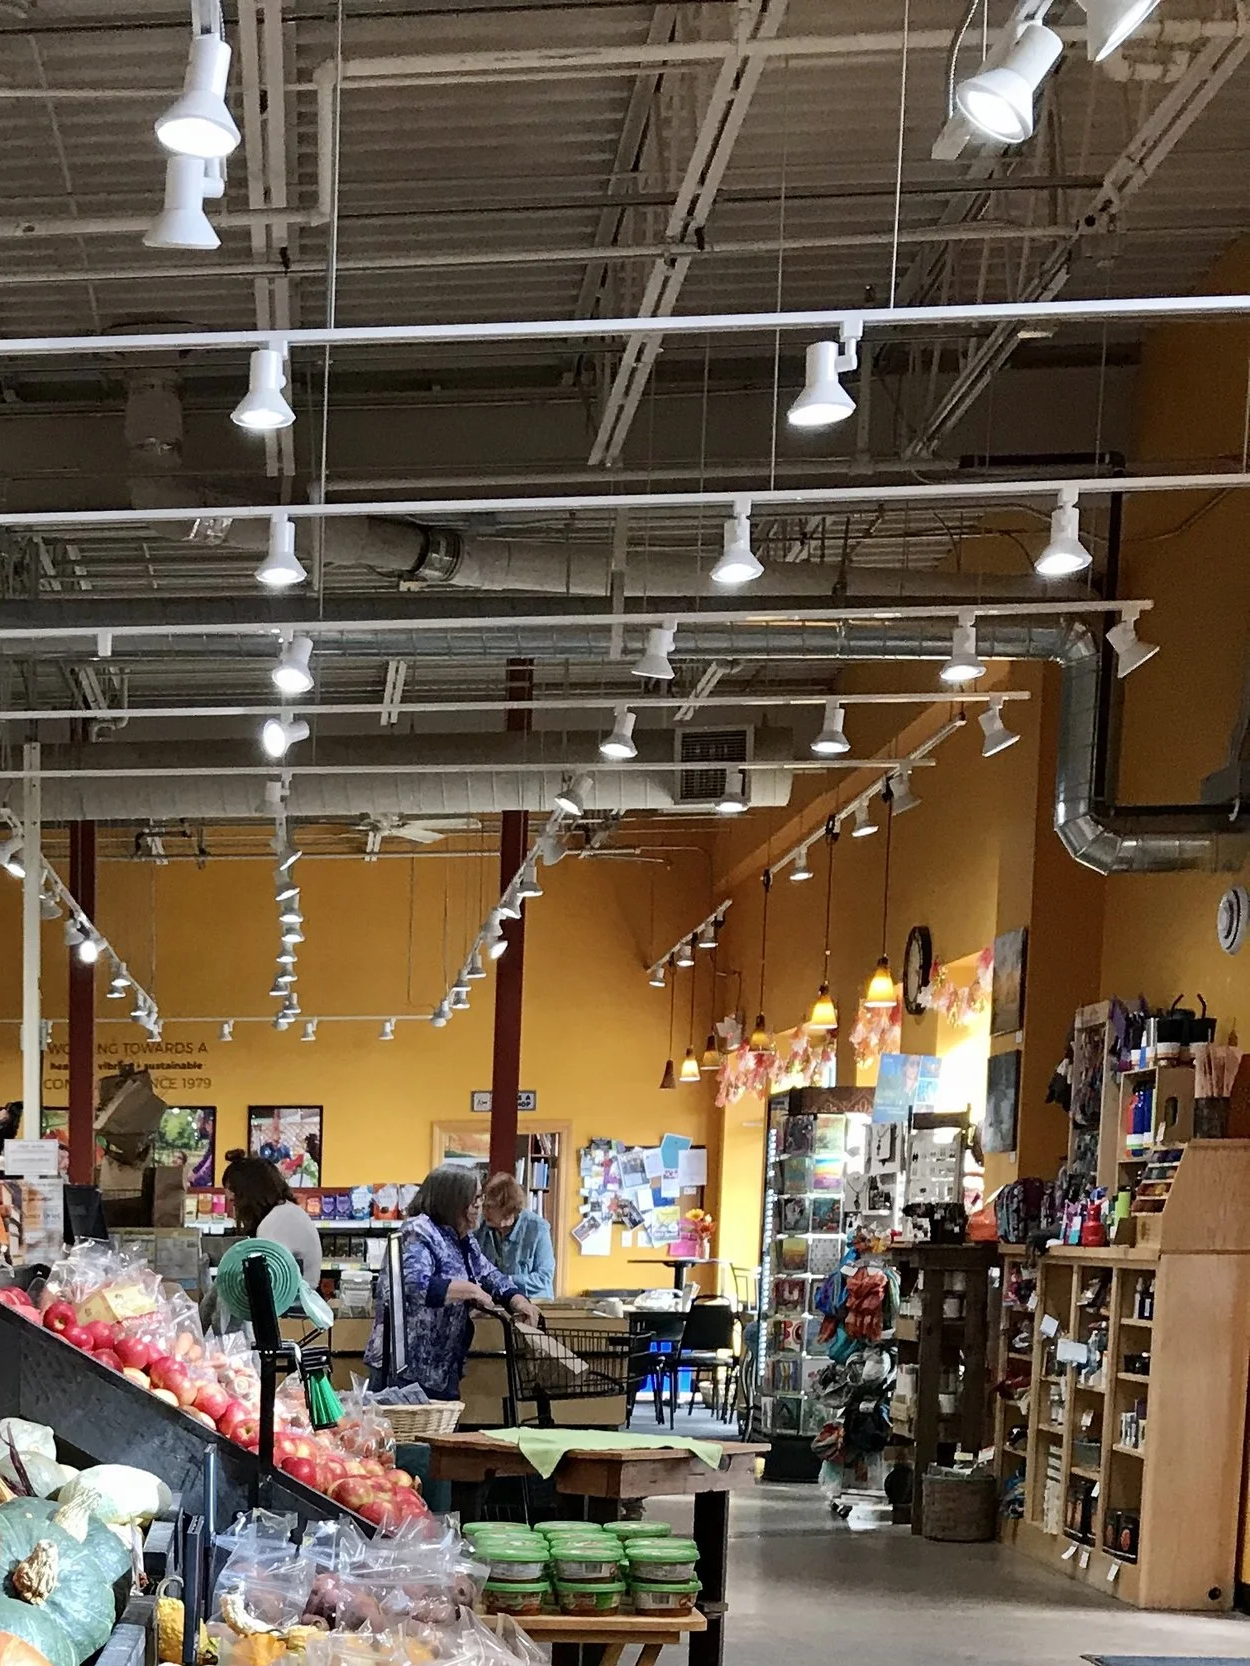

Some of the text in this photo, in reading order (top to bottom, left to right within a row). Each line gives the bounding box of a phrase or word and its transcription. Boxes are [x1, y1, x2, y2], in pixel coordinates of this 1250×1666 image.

[46, 1043, 208, 1055] WONG TOWARDS A
[144, 1062, 203, 1071] sustainable
[154, 1078, 211, 1089] NCE 1979
